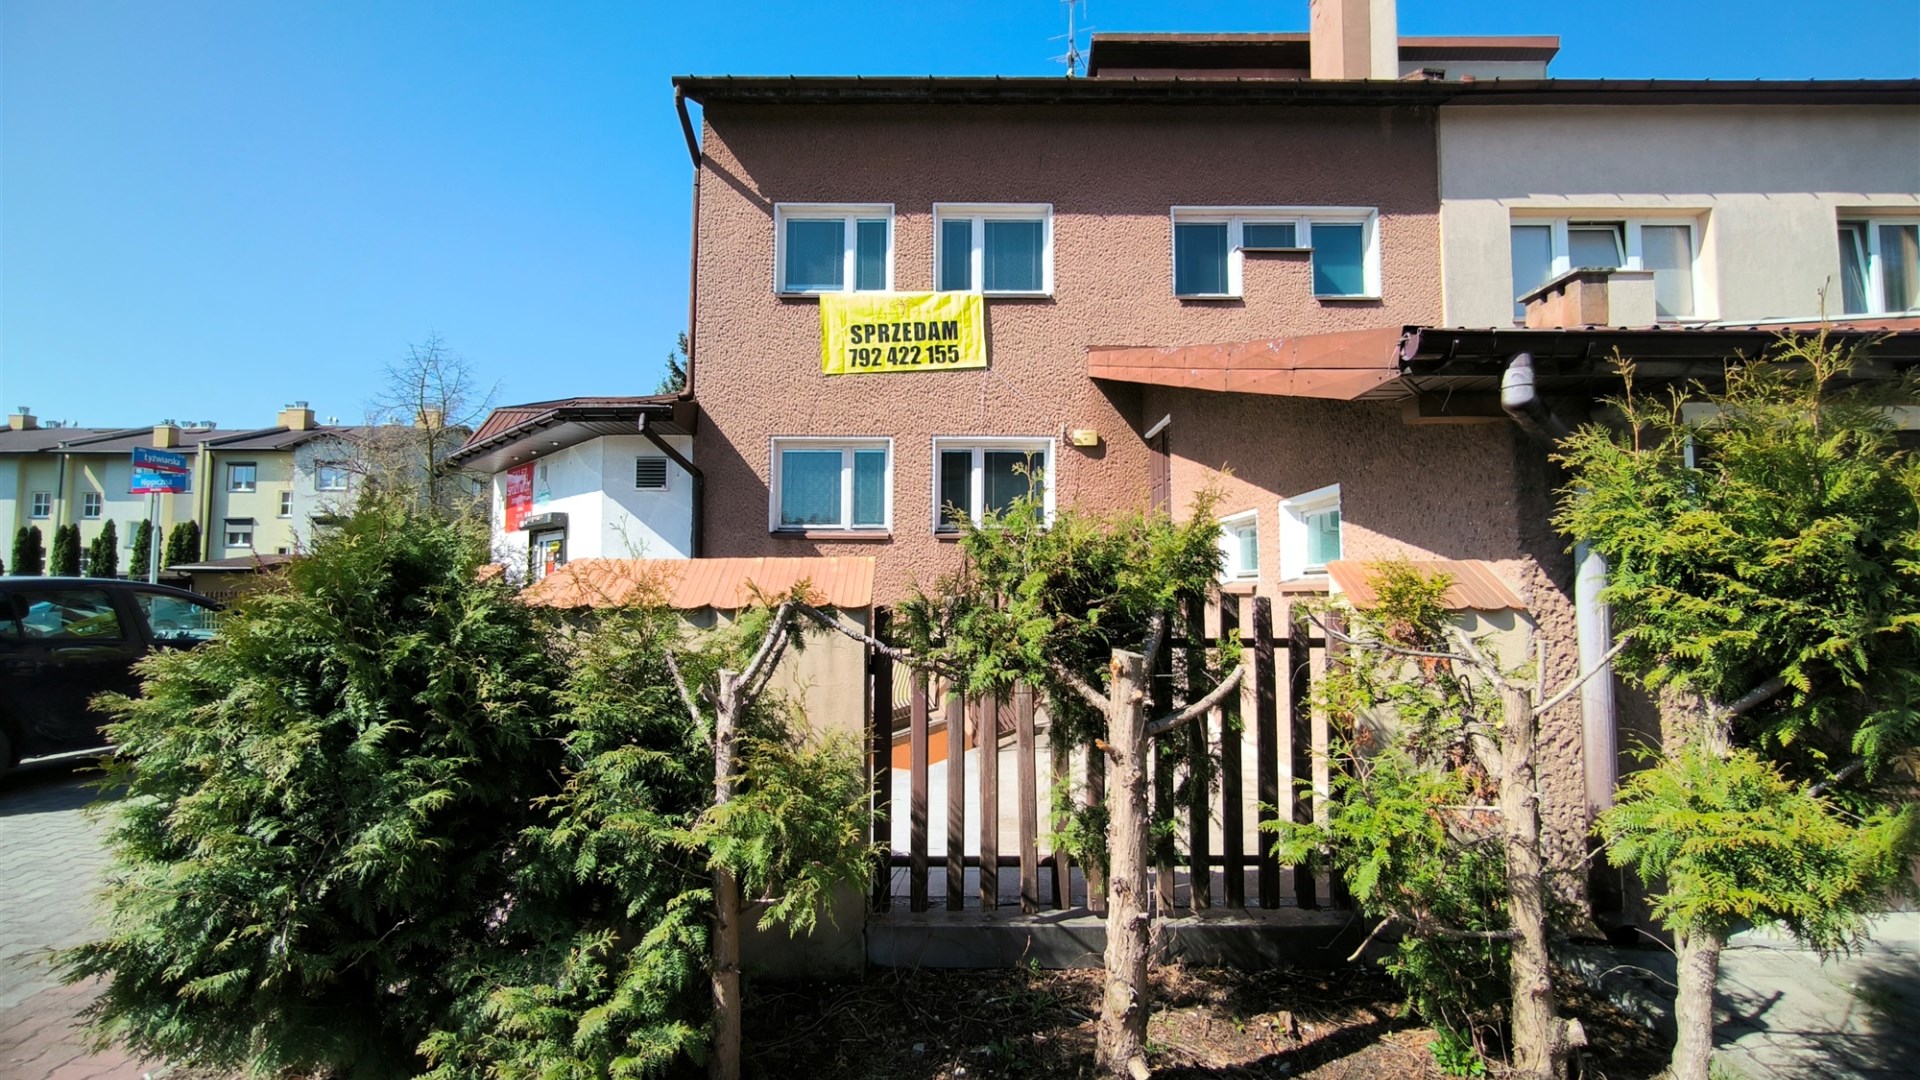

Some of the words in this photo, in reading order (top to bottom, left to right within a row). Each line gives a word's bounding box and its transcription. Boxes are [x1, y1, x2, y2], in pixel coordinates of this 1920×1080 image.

[850, 320, 958, 344] SPRZEDAM
[849, 347, 882, 367] 792
[887, 346, 921, 365] 422
[926, 344, 959, 364] 155
